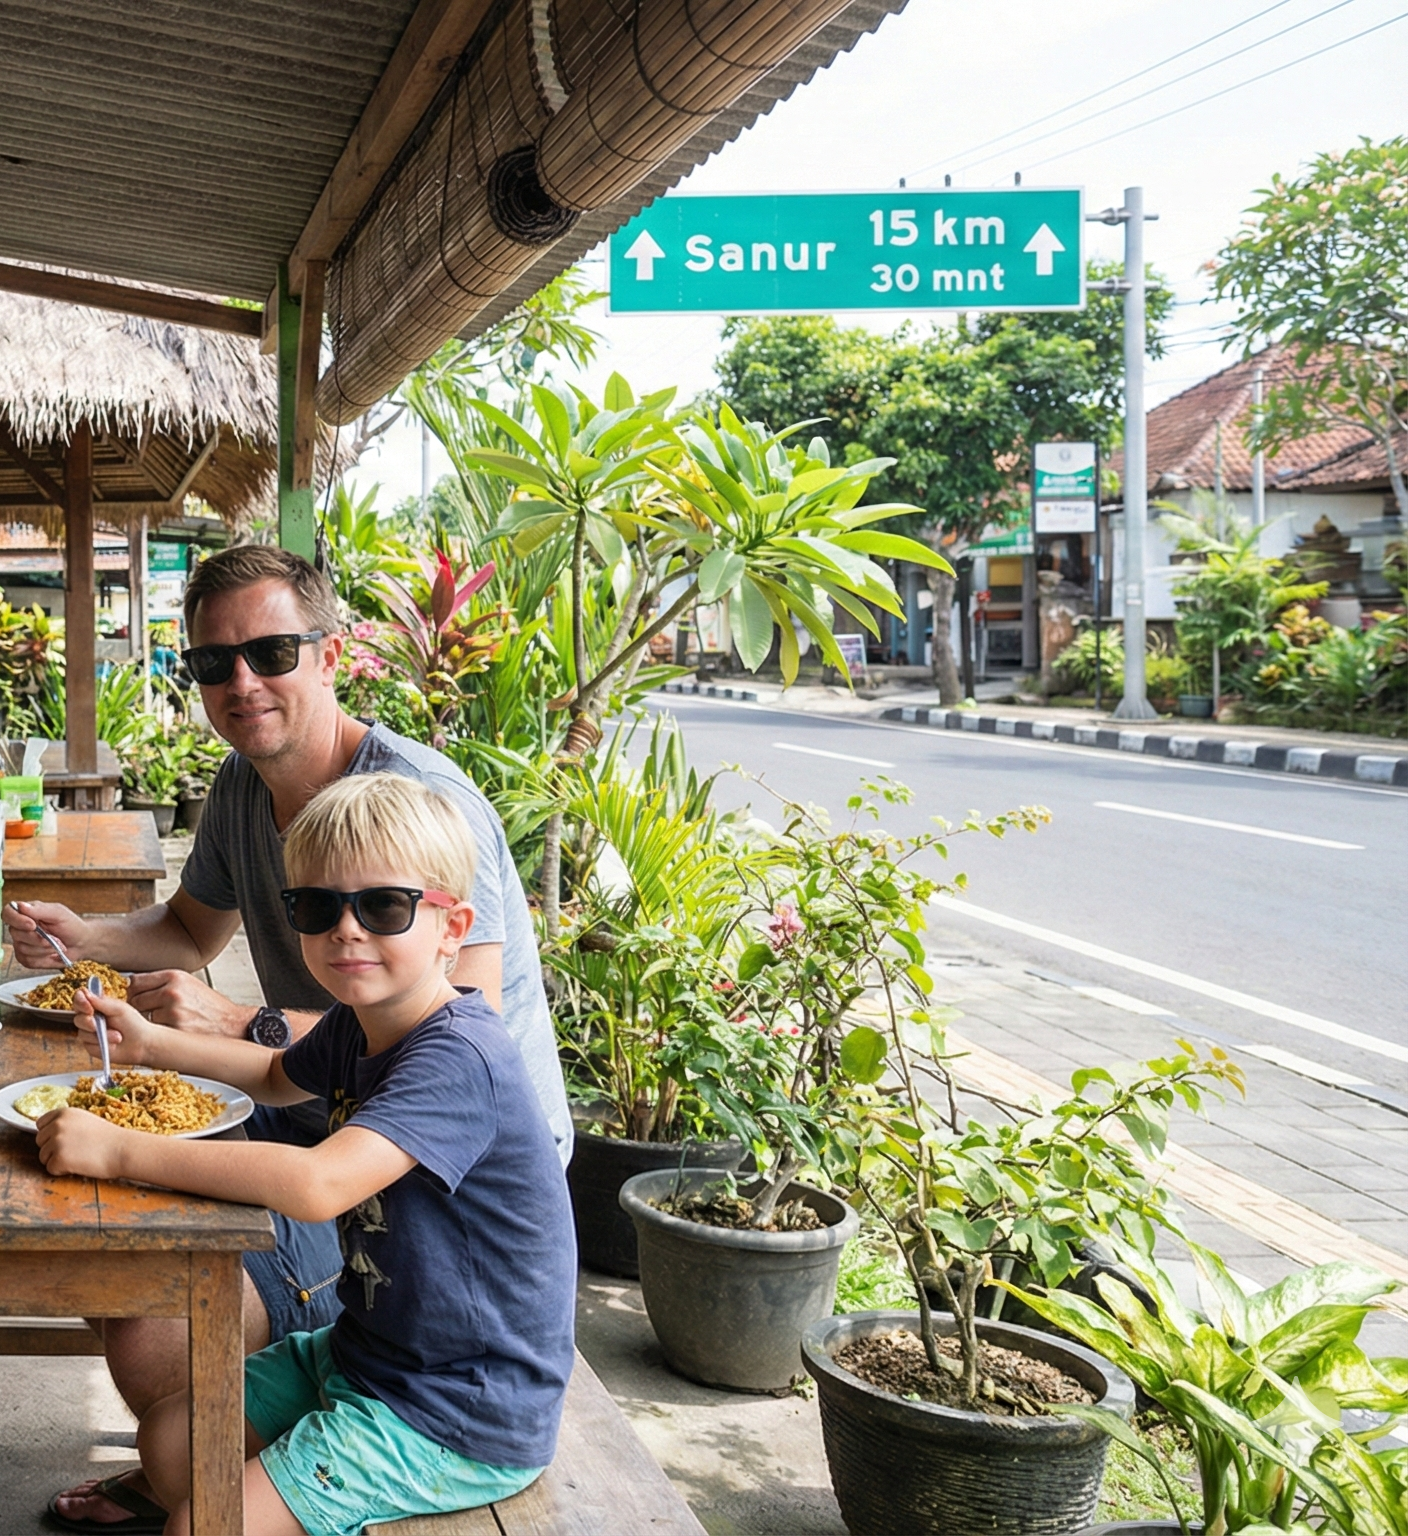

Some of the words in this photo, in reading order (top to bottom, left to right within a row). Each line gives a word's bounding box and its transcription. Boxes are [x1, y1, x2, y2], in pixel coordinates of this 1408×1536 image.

[869, 209, 919, 247] 15
[934, 209, 1005, 246] km
[684, 234, 836, 273] Sanur
[870, 263, 920, 293] 30
[932, 263, 1005, 292] mnt
